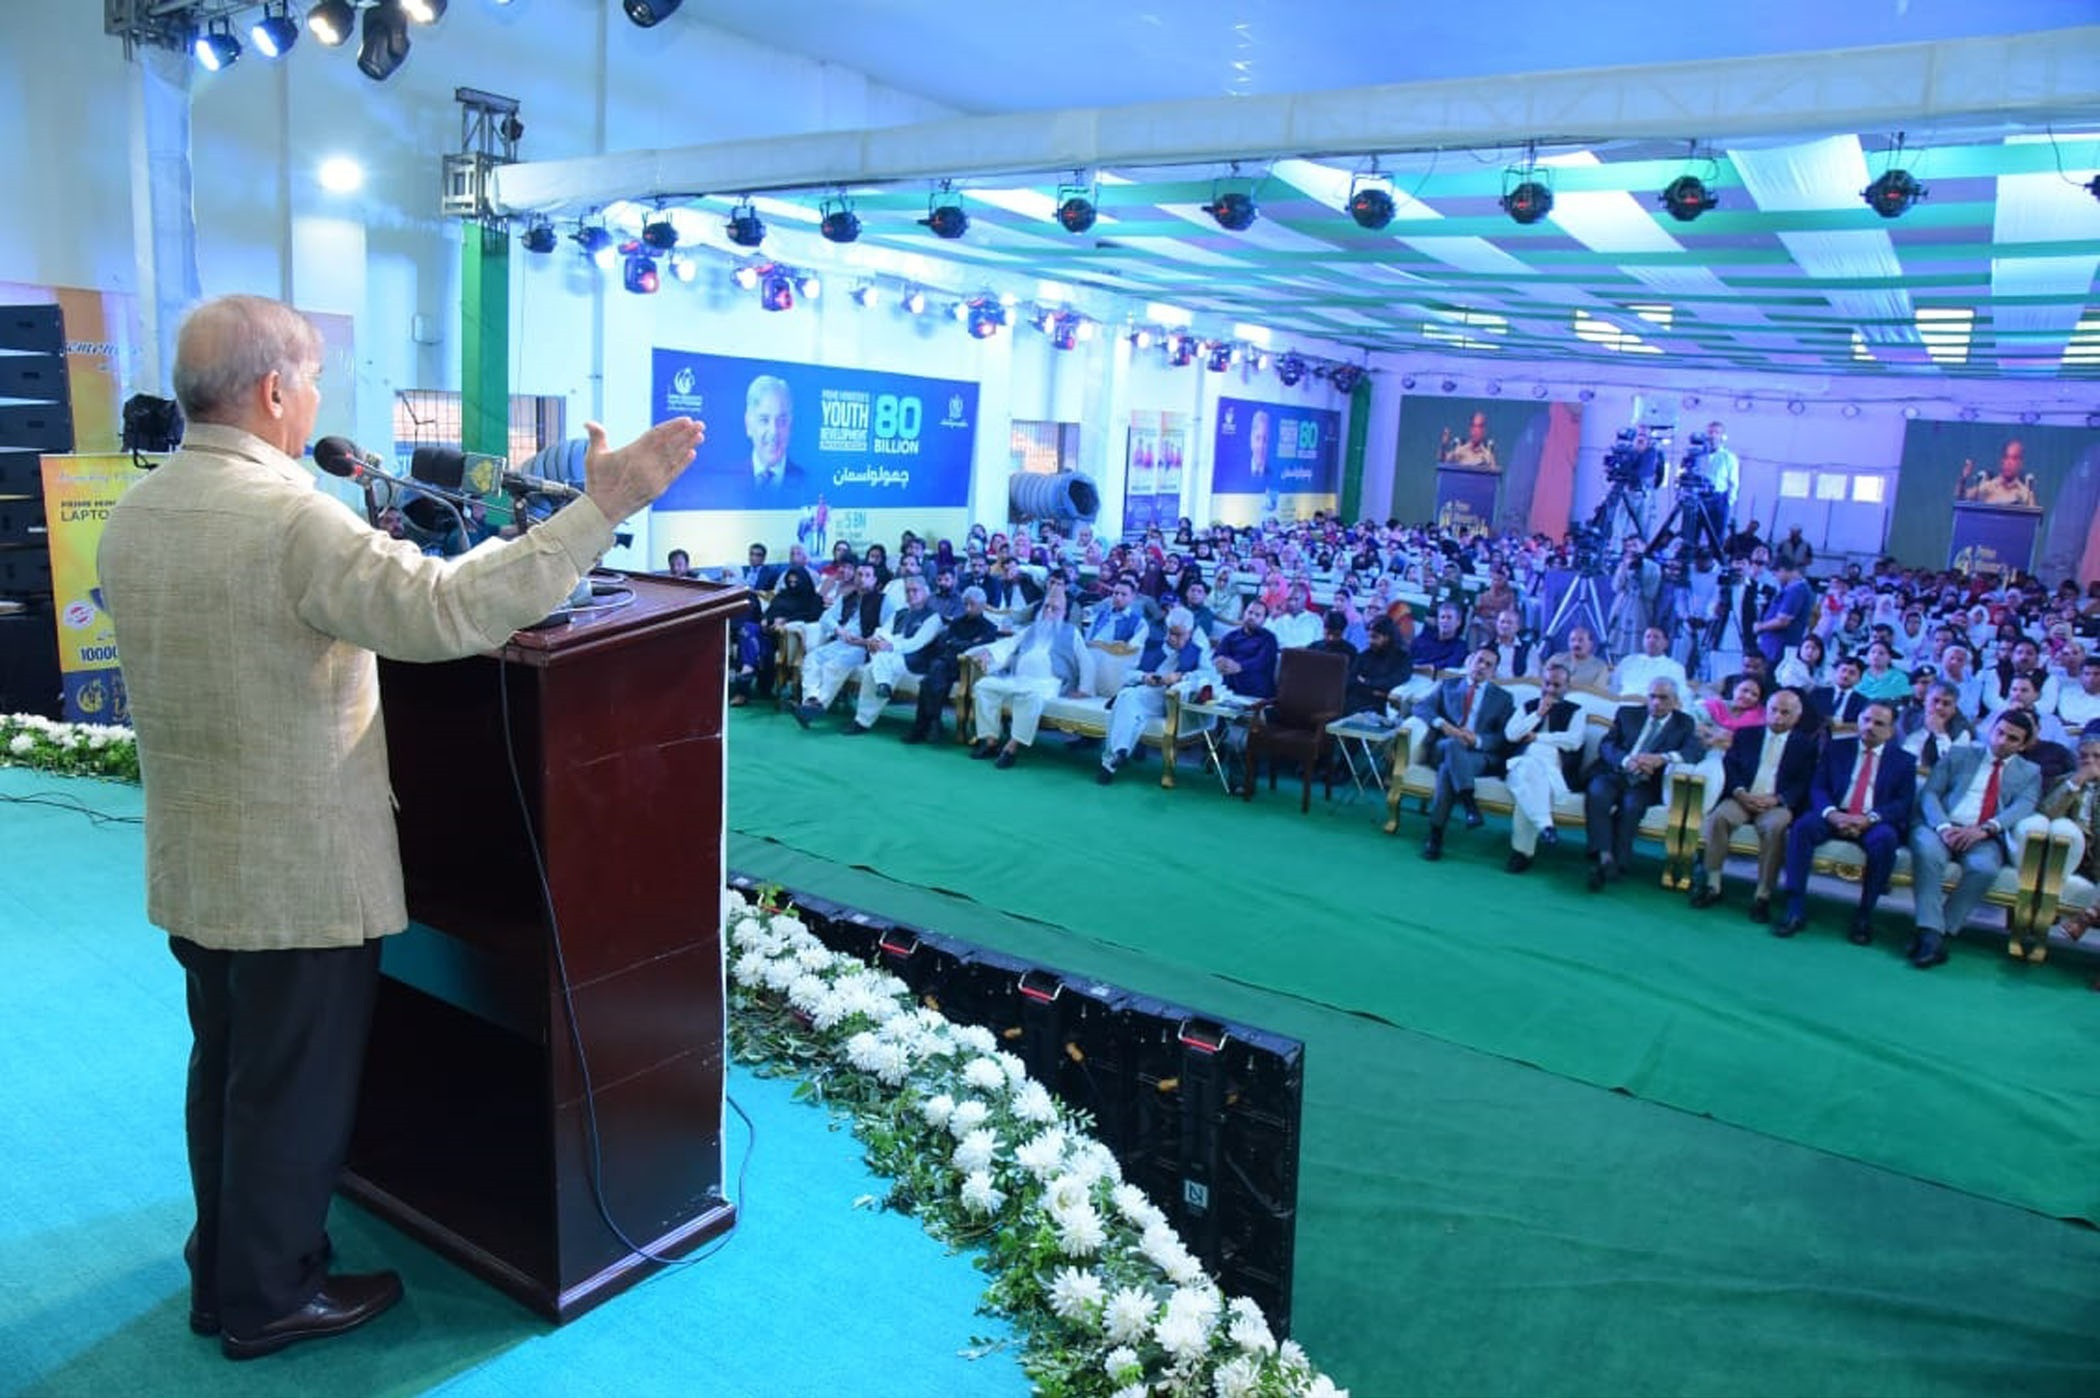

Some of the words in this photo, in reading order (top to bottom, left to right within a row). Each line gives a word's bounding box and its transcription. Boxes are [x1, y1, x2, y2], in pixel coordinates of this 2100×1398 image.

[822, 400, 869, 428] YOUTH
[874, 394, 922, 440] 80
[874, 438, 919, 454] BILLION
